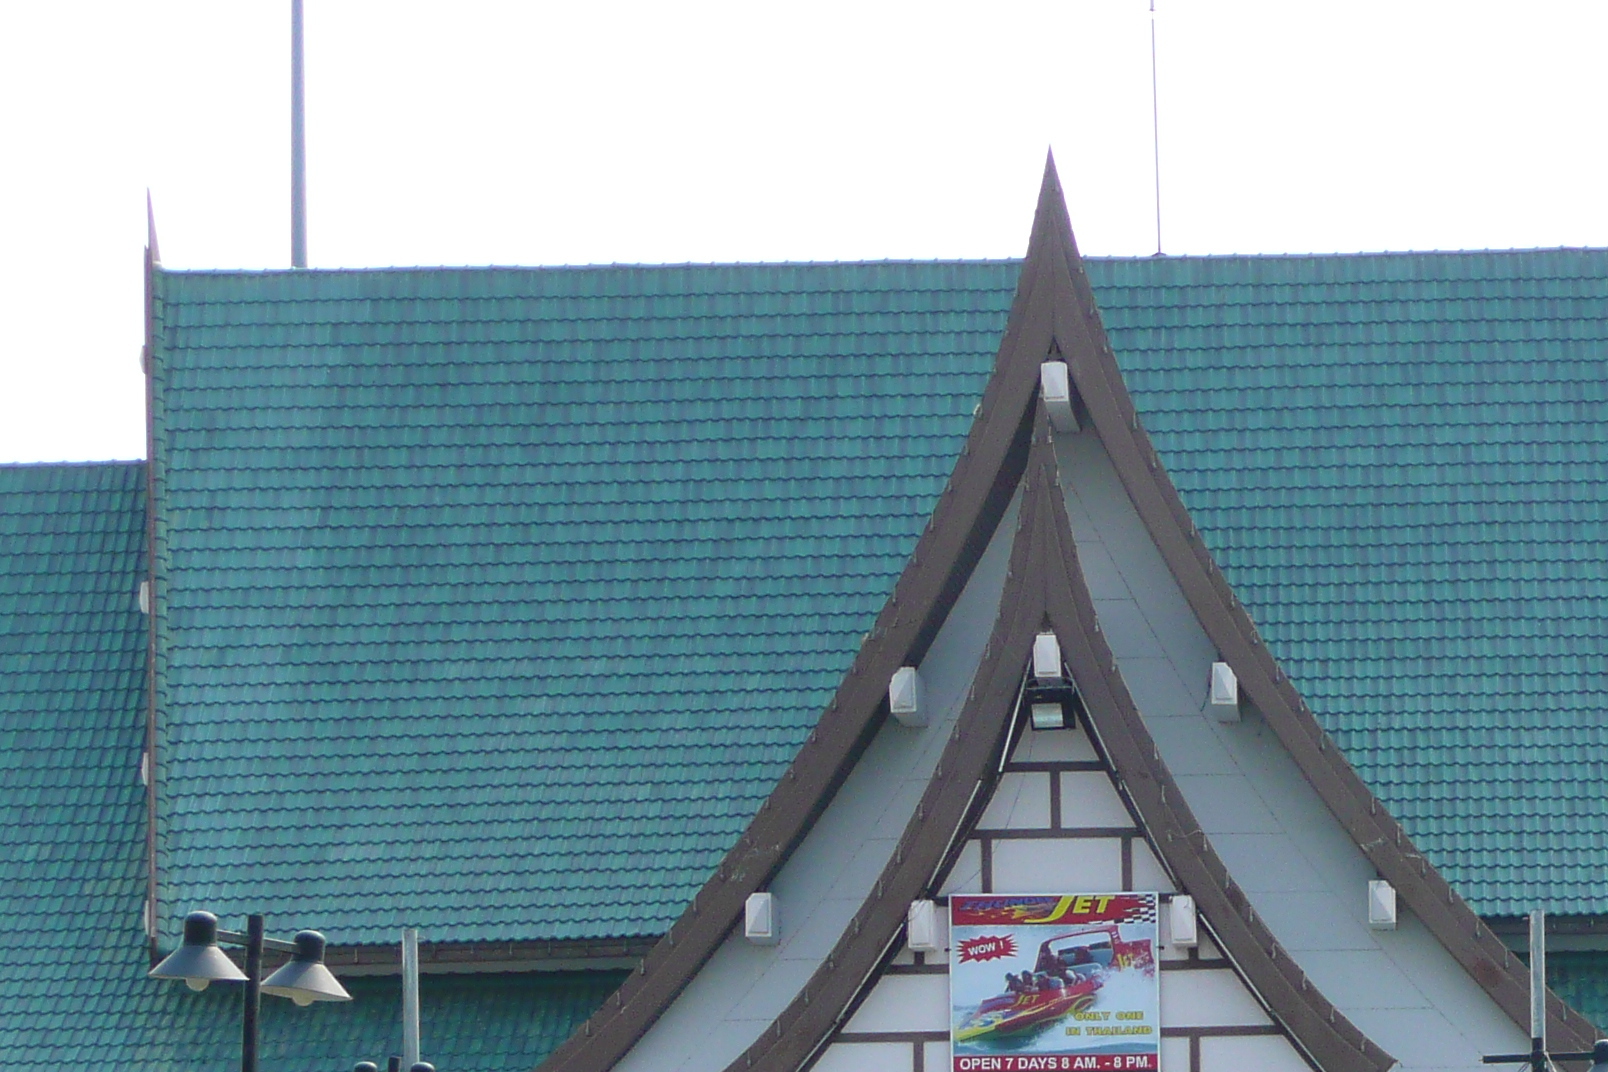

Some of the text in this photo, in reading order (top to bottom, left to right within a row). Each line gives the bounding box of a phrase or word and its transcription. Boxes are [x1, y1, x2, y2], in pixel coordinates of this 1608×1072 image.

[1024, 895, 1116, 924] JET
[968, 942, 996, 956] WOW
[1074, 1011, 1144, 1021] ONLY ONE
[1066, 1025, 1152, 1036] IN THAILAND
[960, 1057, 1001, 1070] OPEN
[1005, 1057, 1014, 1069] 7
[1018, 1057, 1057, 1070] DAYS
[1061, 1057, 1070, 1069] 8
[1073, 1056, 1100, 1069] AM.
[1113, 1056, 1122, 1068] 8
[1126, 1055, 1152, 1068] PM.
